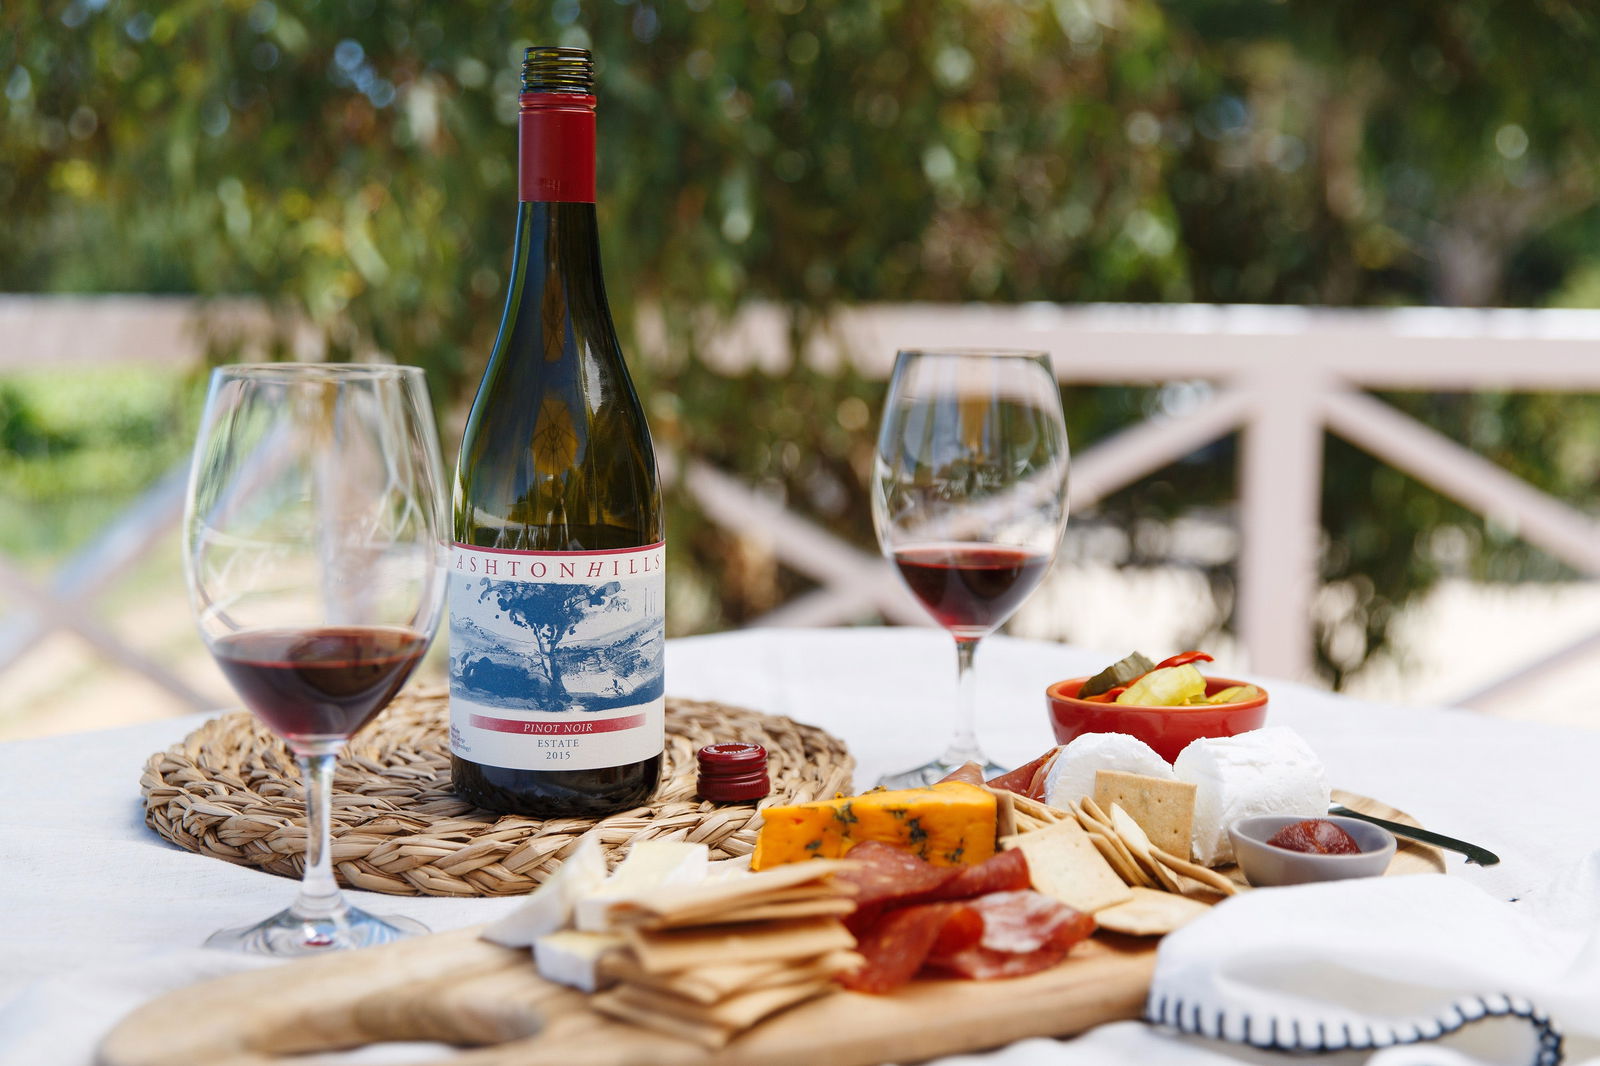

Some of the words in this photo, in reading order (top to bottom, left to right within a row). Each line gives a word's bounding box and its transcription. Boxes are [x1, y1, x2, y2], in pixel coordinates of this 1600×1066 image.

[523, 723, 560, 733] PINOT
[564, 723, 593, 733] NOIR
[537, 739, 580, 748] ESTATE
[546, 751, 571, 760] 2015
